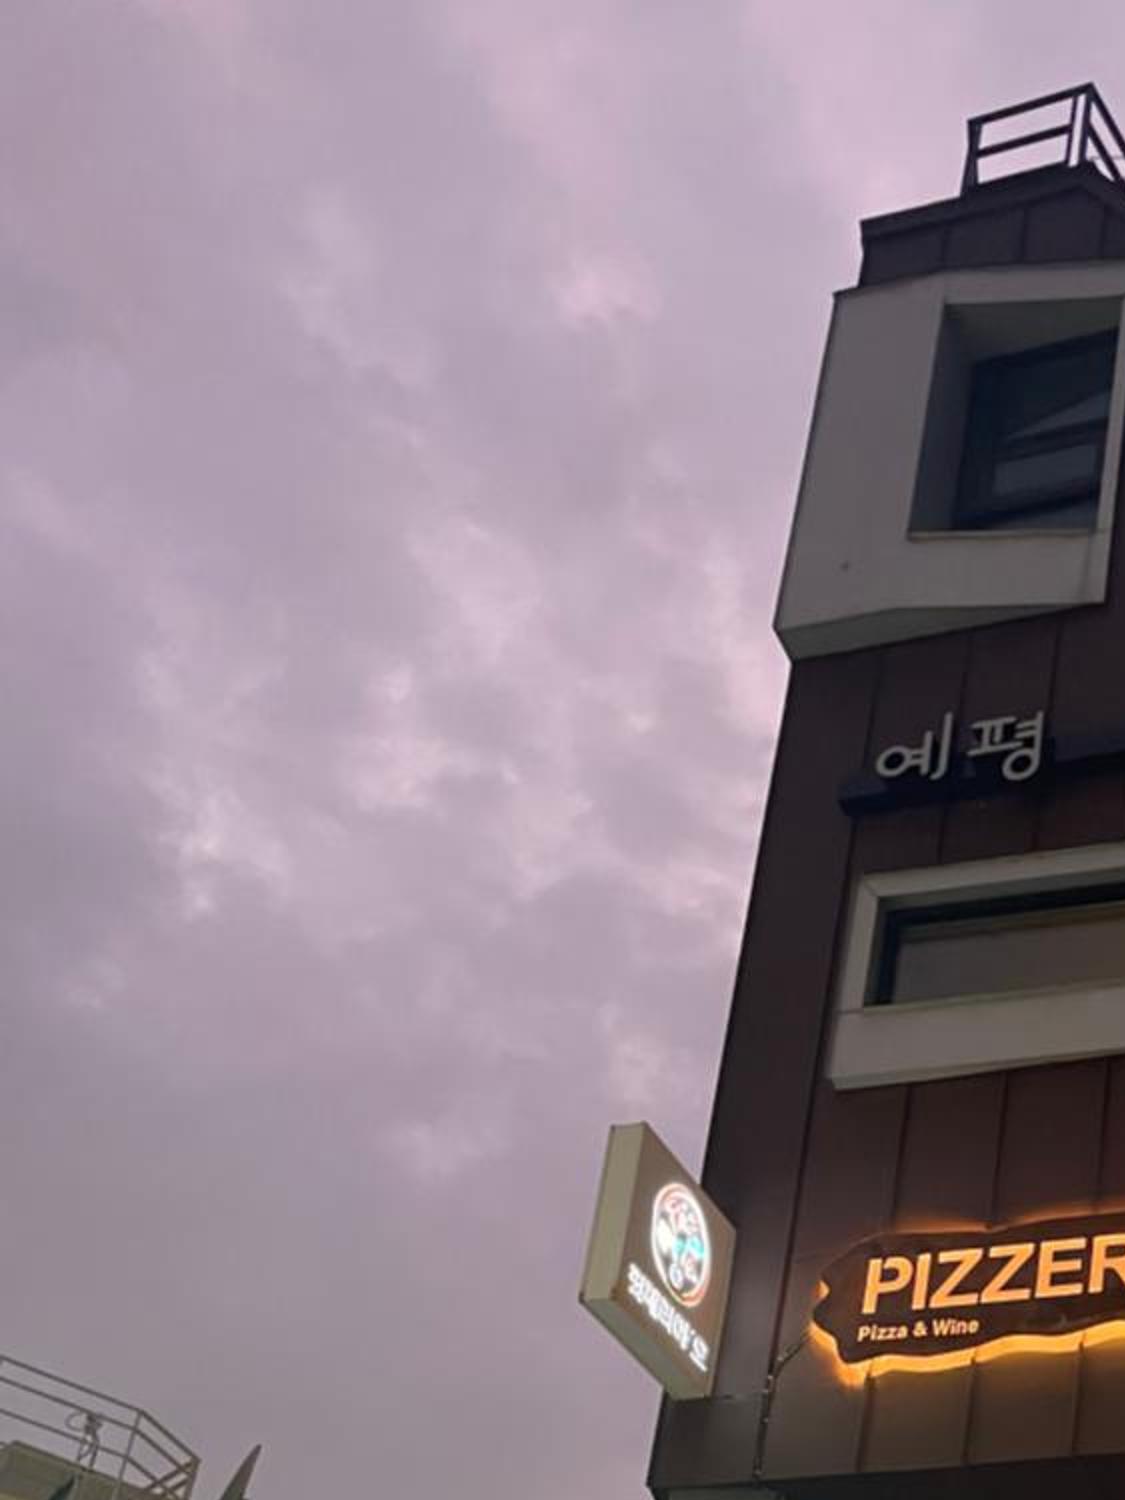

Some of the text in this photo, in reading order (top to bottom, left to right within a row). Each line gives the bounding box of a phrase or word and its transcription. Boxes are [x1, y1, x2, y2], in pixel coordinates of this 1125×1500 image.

[875, 710, 1045, 782] 예평
[857, 1319, 980, 1342] Pizza & Wine
